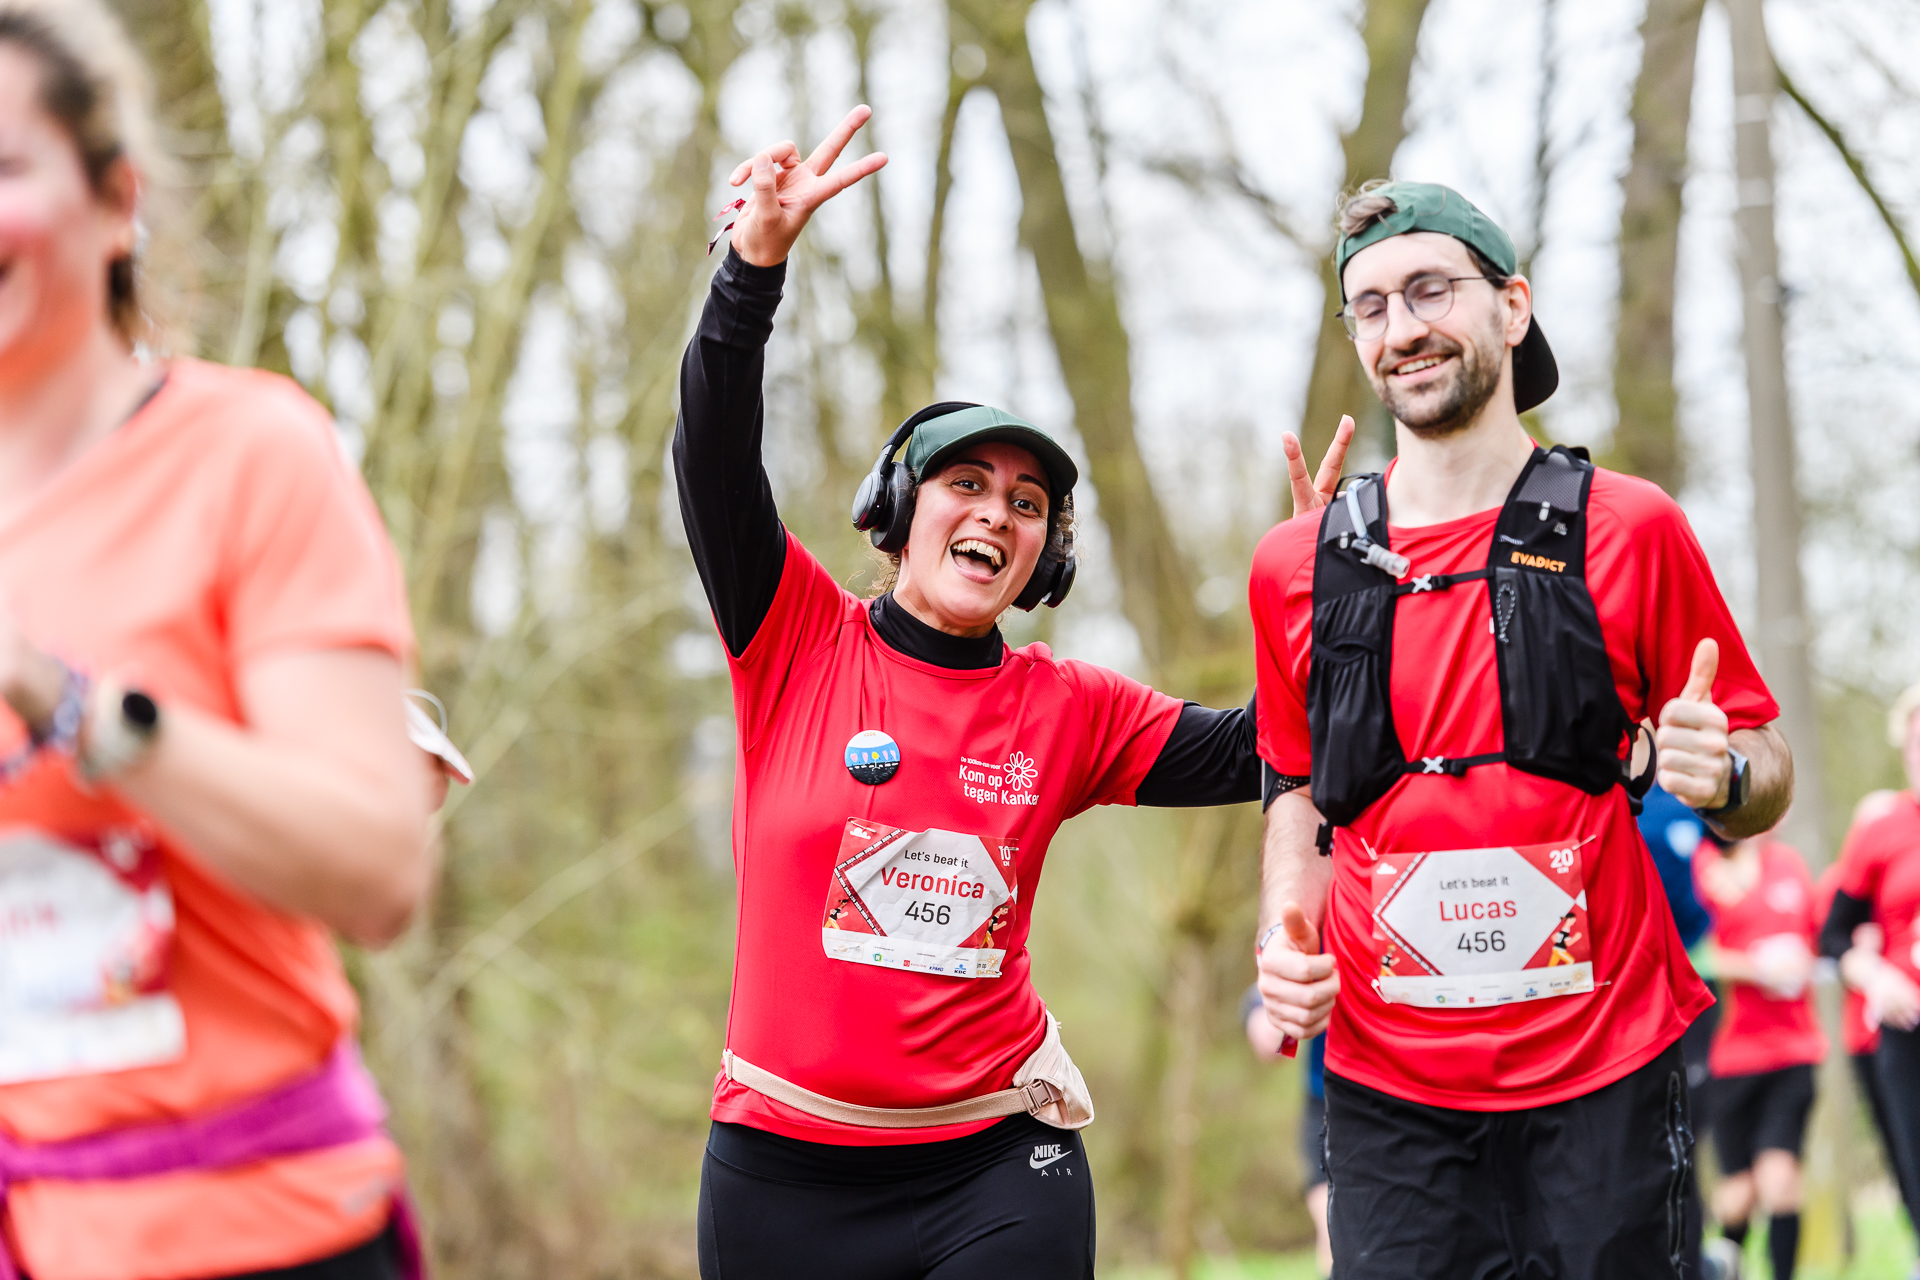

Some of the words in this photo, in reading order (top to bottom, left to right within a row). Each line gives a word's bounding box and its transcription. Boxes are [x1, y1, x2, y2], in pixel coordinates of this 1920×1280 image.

[1511, 551, 1566, 573] EVADICT
[959, 765, 985, 784] Kom
[988, 775, 1002, 790] op
[964, 783, 997, 803] tegen
[904, 850, 931, 862] Let's
[933, 853, 959, 867] beat
[961, 858, 969, 868] it
[998, 846, 1011, 861] 10
[1549, 848, 1574, 869] 20
[881, 866, 985, 899] Veronica
[1440, 878, 1468, 890] Let's
[1471, 877, 1497, 889] beat
[1501, 876, 1509, 886] it
[905, 900, 951, 925] 456
[1439, 900, 1517, 922] Lucas
[1457, 930, 1506, 953] 456
[1034, 1144, 1061, 1159] NIKE
[1041, 1168, 1072, 1177] AIR
